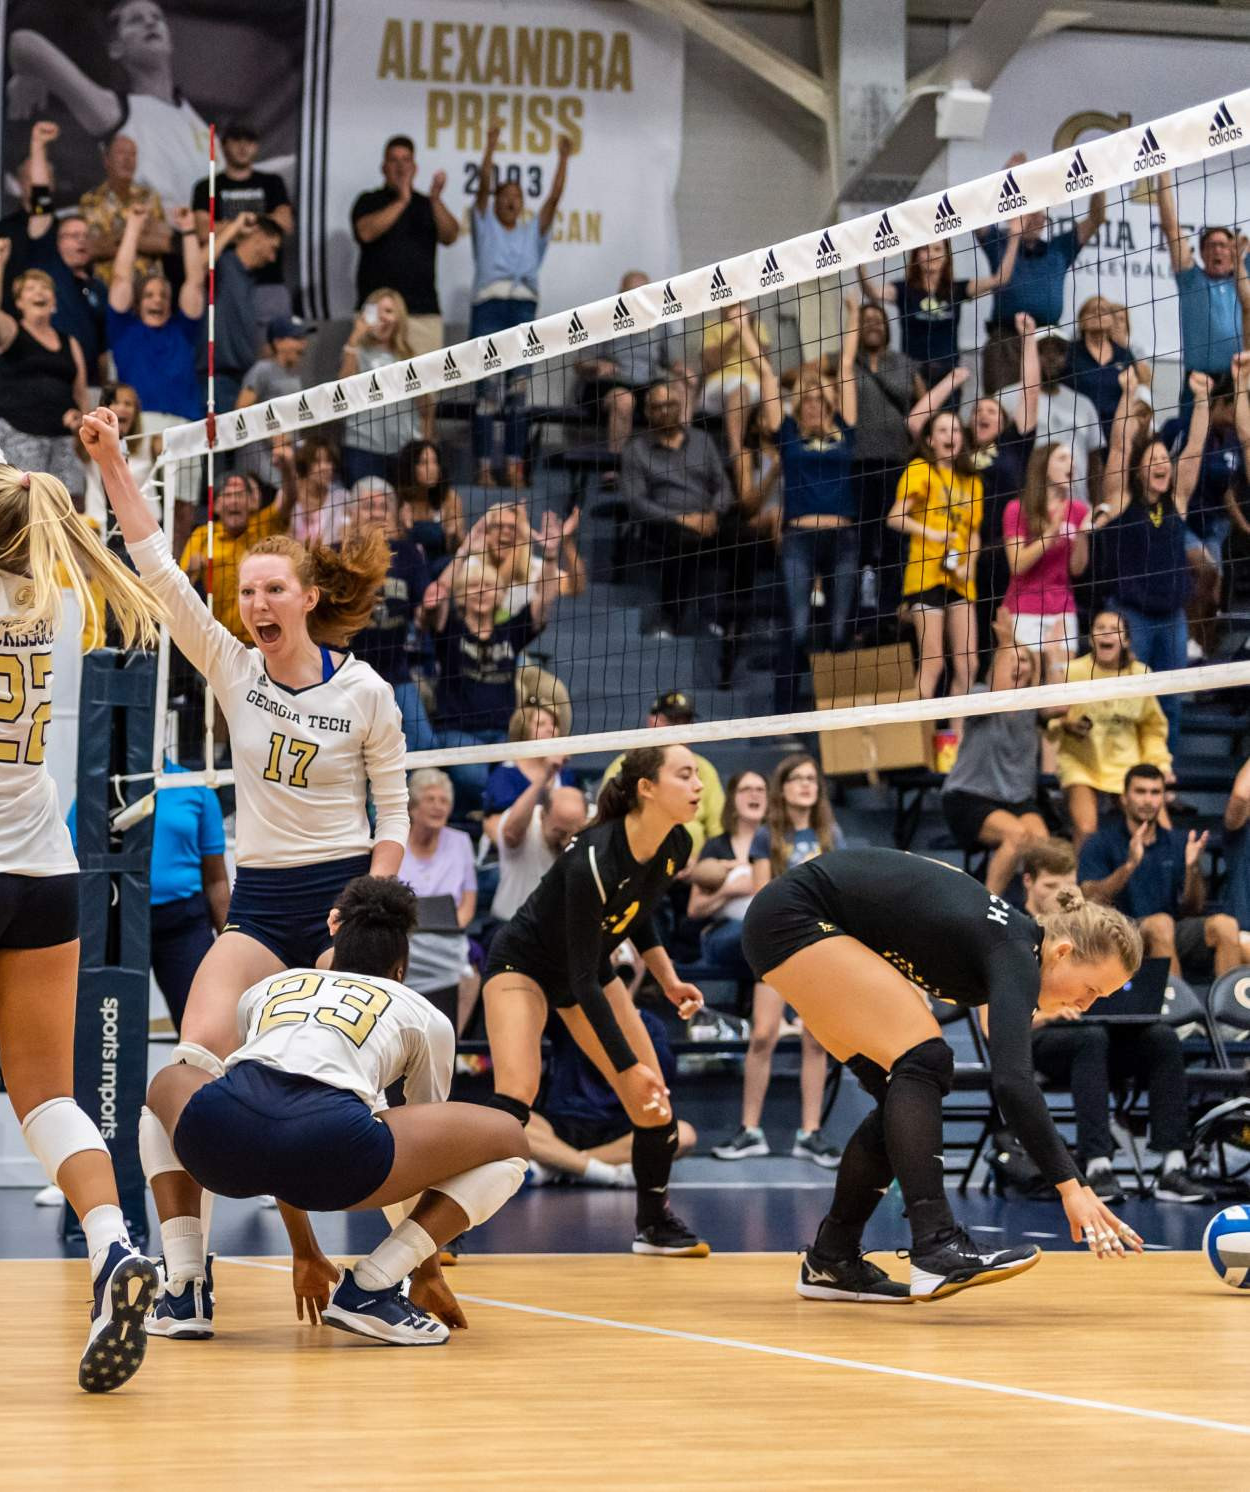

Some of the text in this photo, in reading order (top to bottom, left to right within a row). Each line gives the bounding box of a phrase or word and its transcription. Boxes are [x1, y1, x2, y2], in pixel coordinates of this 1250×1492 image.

[377, 18, 634, 92] ALEXANDRA
[426, 89, 585, 155] PREISS
[1209, 127, 1243, 147] adidas
[1134, 152, 1167, 172] adidas
[1065, 174, 1094, 193] adidas
[998, 195, 1027, 213] adidas
[934, 216, 962, 234] adidas
[873, 235, 900, 252] adidas
[816, 252, 842, 269] adidas
[760, 271, 785, 288] adidas
[710, 286, 733, 301] adidas
[613, 318, 635, 331] adidas
[568, 331, 589, 345] adidas
[308, 714, 352, 733] TECH
[263, 732, 320, 788] 17
[256, 972, 394, 1049] 23
[98, 997, 120, 1140] sports imports
